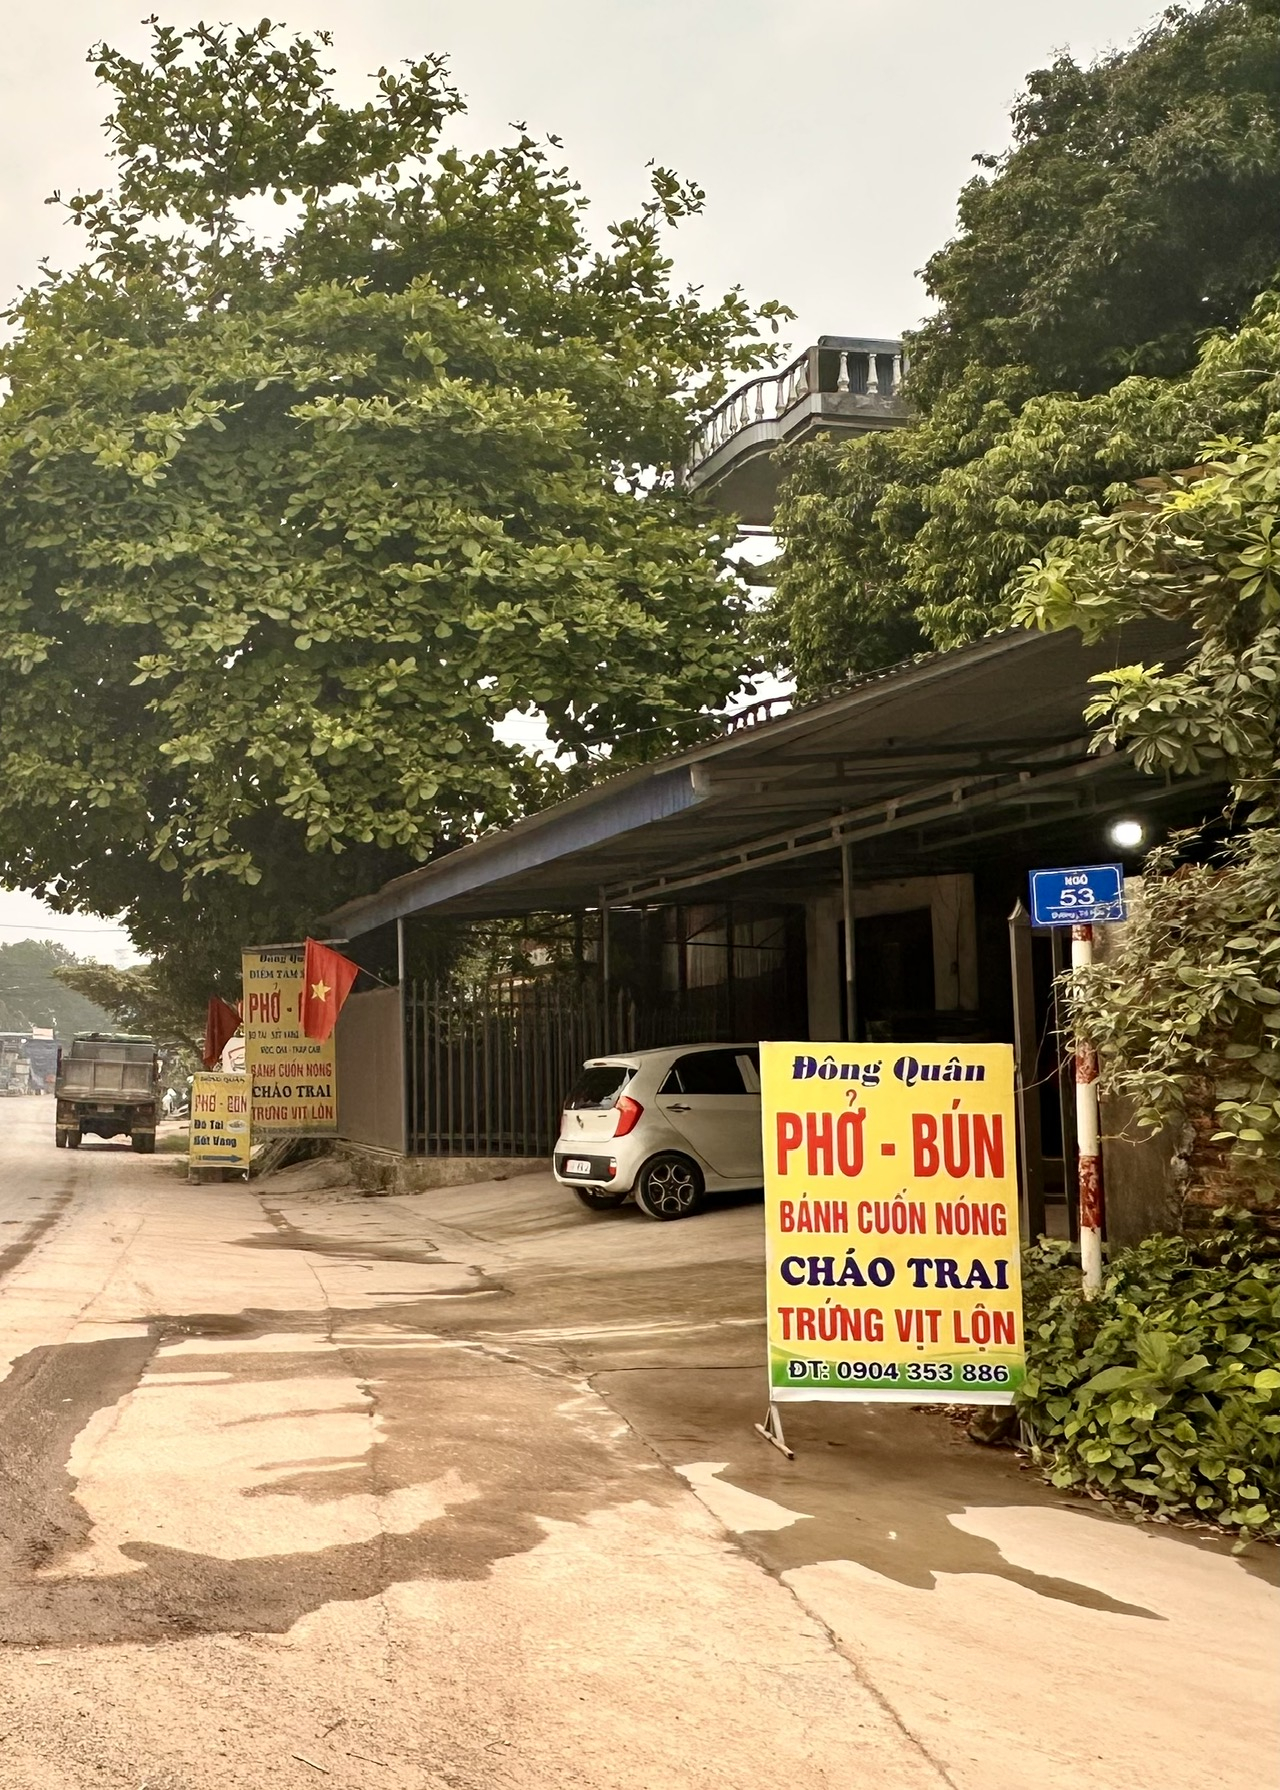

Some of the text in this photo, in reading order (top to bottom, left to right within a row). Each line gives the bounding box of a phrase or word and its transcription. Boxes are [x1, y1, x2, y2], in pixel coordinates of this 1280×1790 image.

[1060, 888, 1095, 907] 53
[249, 982, 280, 1024] PHỞ
[296, 1084, 332, 1098] TRAI
[791, 1056, 986, 1087] Đông Quân
[776, 1088, 1005, 1179] PHỞ - BÚN
[779, 1188, 1008, 1236] BÁNH CUỐN NÓNG
[780, 1247, 1010, 1290] CHÁO TRAI
[777, 1297, 1016, 1353] TRỨNG VỊT LỘN
[788, 1360, 1010, 1383] ĐT: 0904 353 886
